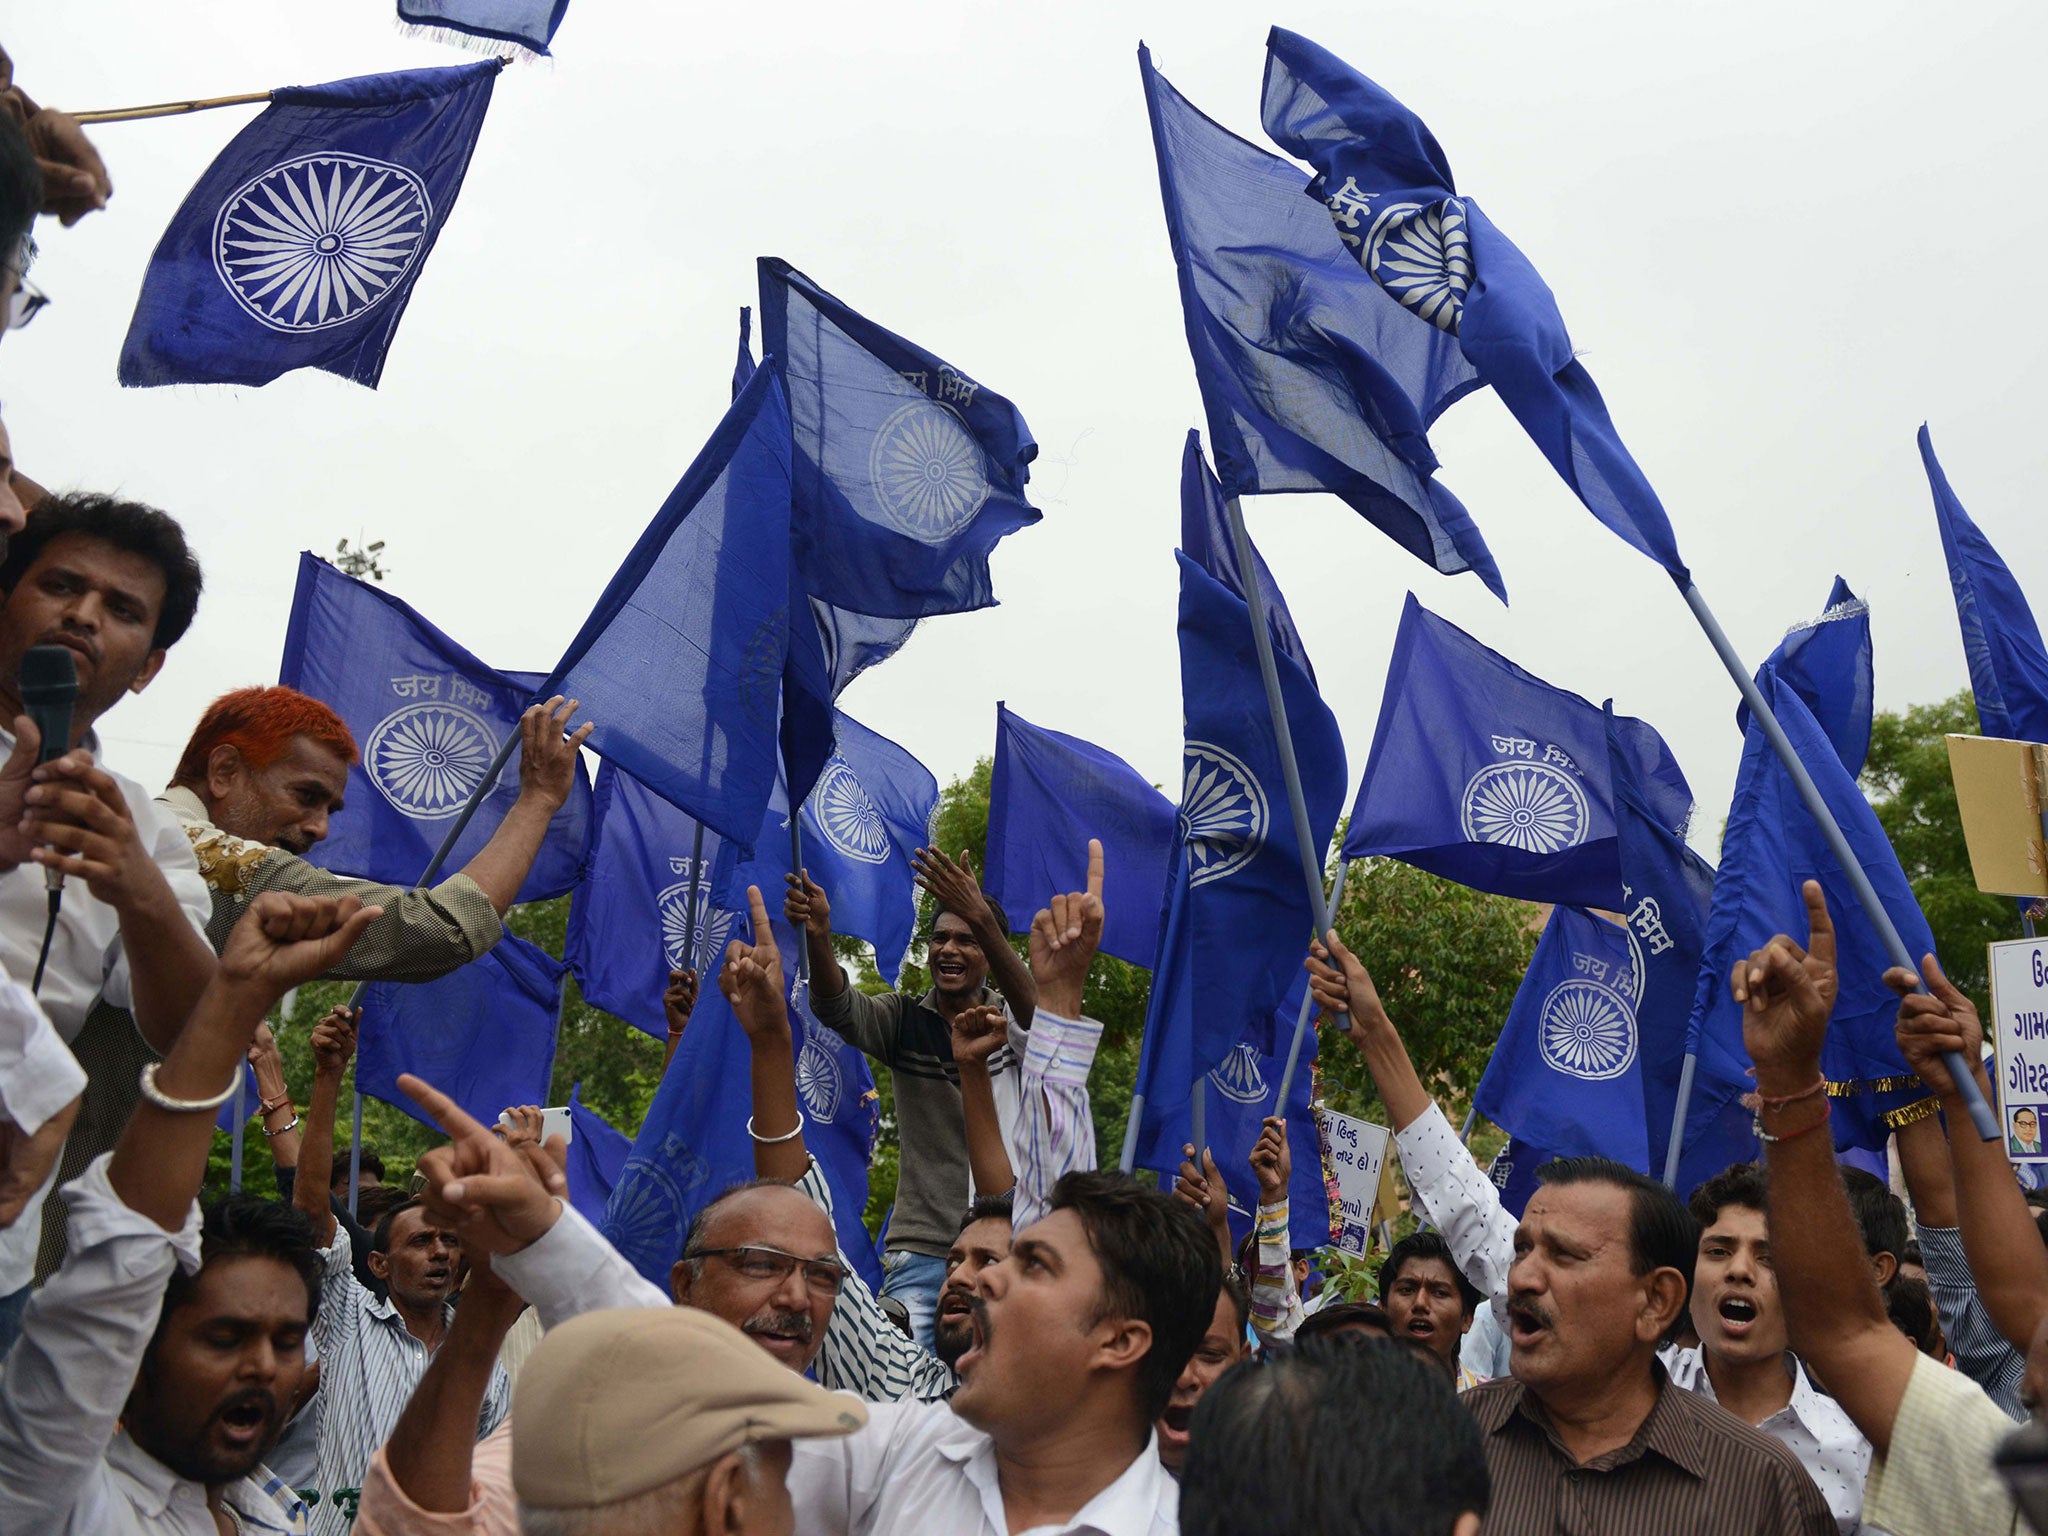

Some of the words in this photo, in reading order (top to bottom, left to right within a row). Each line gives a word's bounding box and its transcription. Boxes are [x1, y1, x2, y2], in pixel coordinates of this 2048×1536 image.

[390, 674, 442, 698] जय
[1491, 734, 1537, 759] जय
[1627, 897, 1675, 955] भिम
[1573, 951, 1610, 981] जय
[2014, 1011, 2048, 1041] ગામ
[1357, 1151, 1370, 1171] હો
